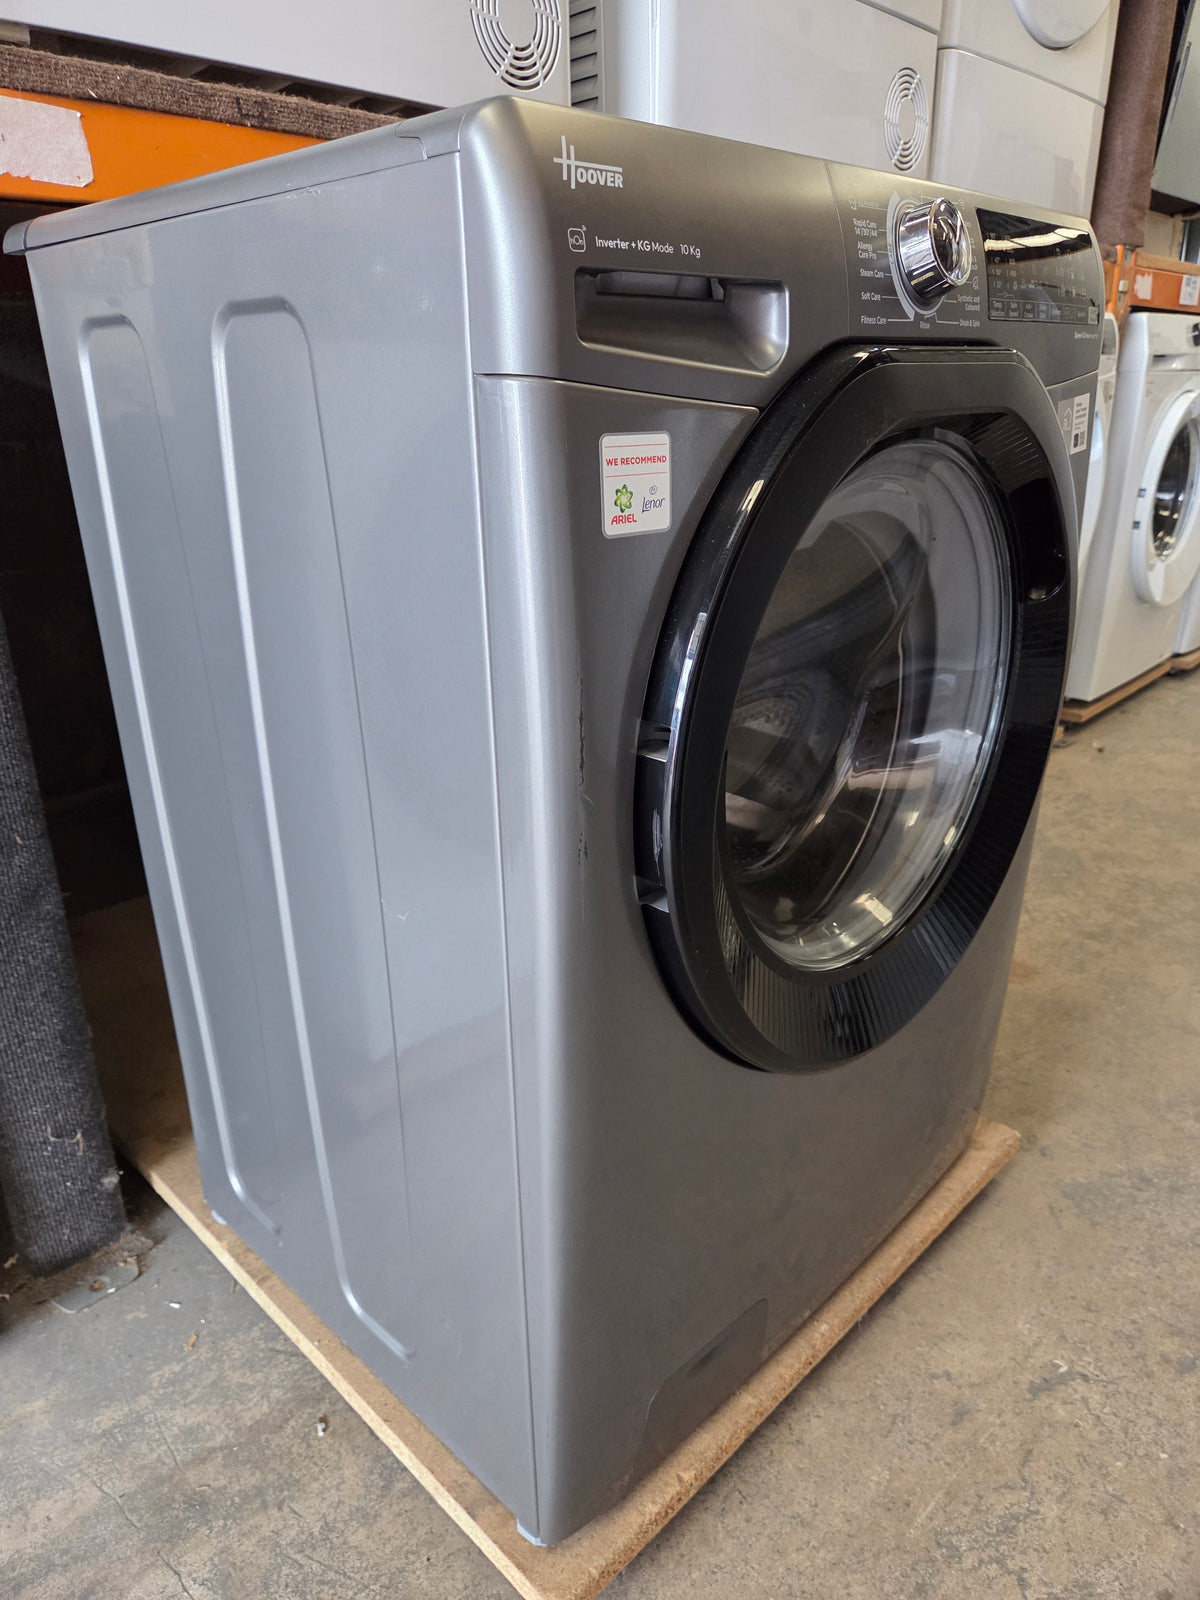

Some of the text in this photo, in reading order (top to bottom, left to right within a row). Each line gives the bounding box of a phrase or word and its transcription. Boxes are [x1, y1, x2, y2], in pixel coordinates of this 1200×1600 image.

[553, 135, 623, 190] HOOVER
[595, 236, 629, 250] Inverter
[637, 240, 650, 252] KG
[652, 242, 674, 254] Mode
[680, 244, 689, 255] 10
[690, 246, 701, 259] Kg
[860, 268, 884, 278] Steam Care
[861, 291, 881, 301] Soft Care
[876, 316, 887, 325] Care
[605, 455, 667, 466] WE RECOMMEND
[642, 497, 665, 513] Lenor
[611, 514, 637, 525] ARIEL
